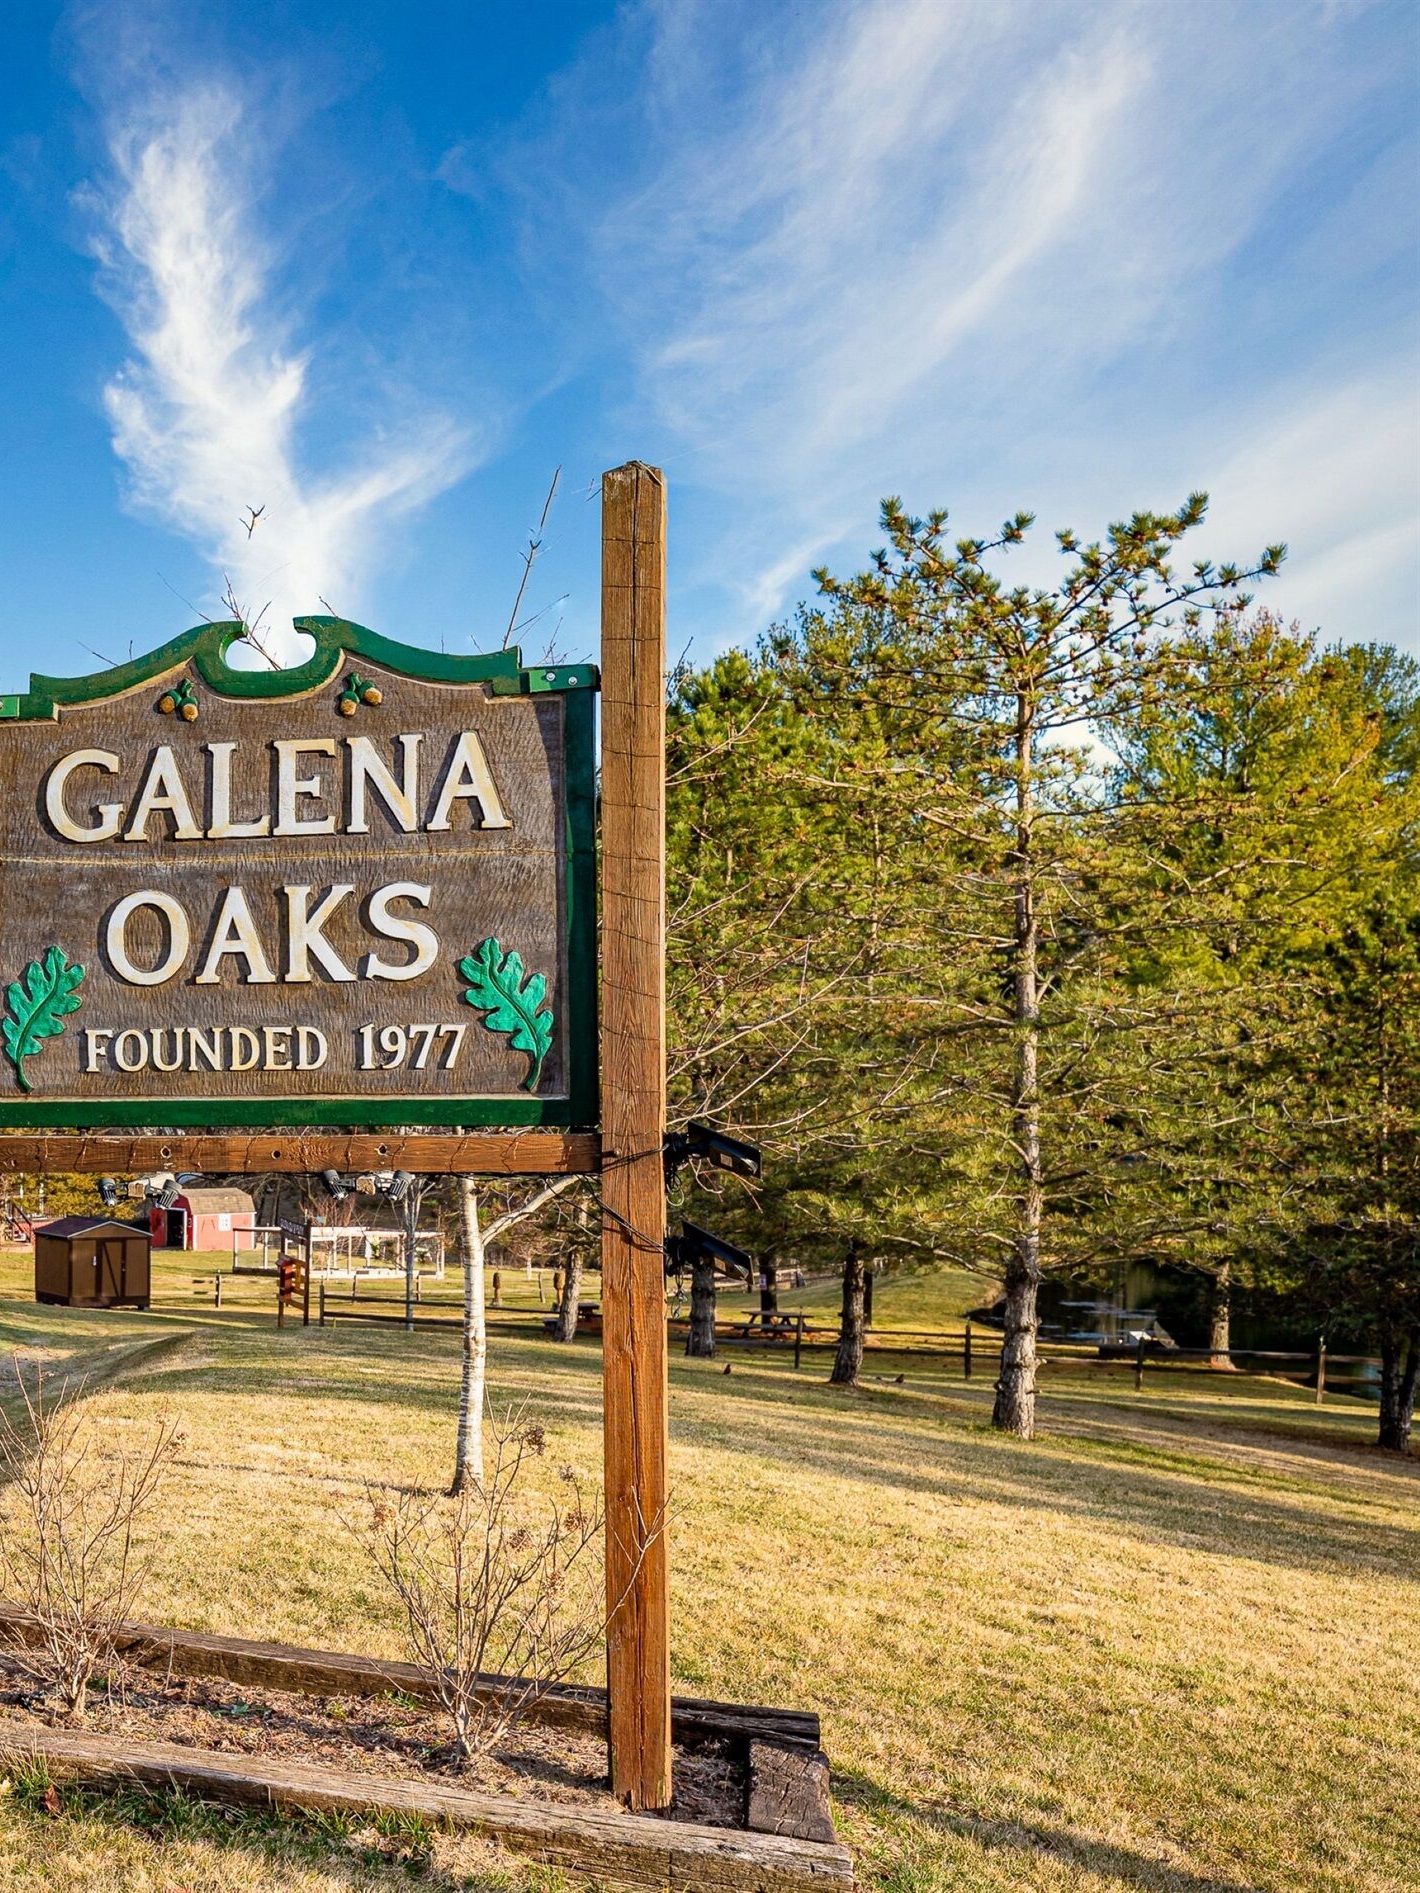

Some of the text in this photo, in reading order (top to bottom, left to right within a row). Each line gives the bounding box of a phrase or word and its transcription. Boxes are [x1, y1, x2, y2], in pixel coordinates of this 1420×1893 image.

[46, 731, 514, 842] GALENA
[107, 882, 439, 985] OAKS
[85, 1023, 467, 1072] FOUNDED 1977
